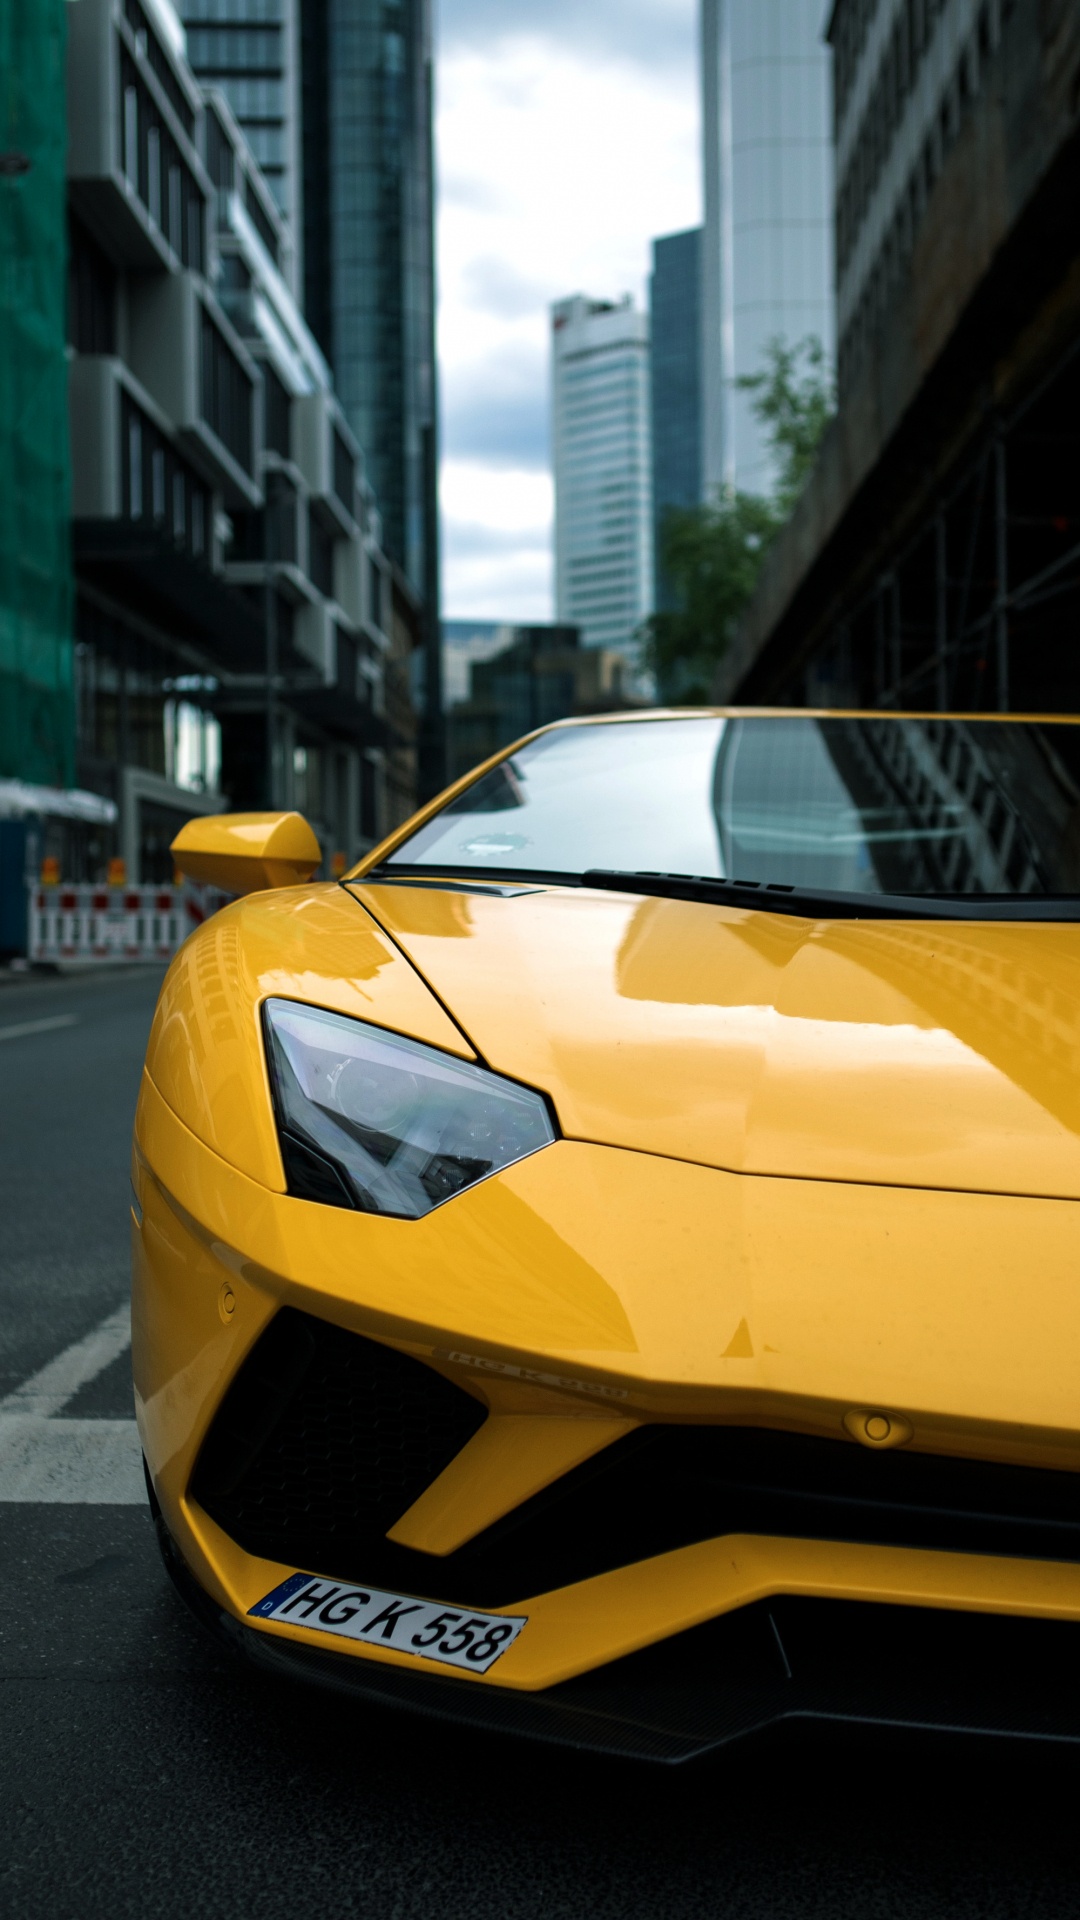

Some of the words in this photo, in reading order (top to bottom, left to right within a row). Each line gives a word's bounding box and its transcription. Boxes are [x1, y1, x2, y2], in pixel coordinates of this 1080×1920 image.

[261, 1601, 273, 1611] D
[280, 1582, 371, 1625] HG
[360, 1600, 425, 1640] K
[411, 1612, 513, 1662] 558
